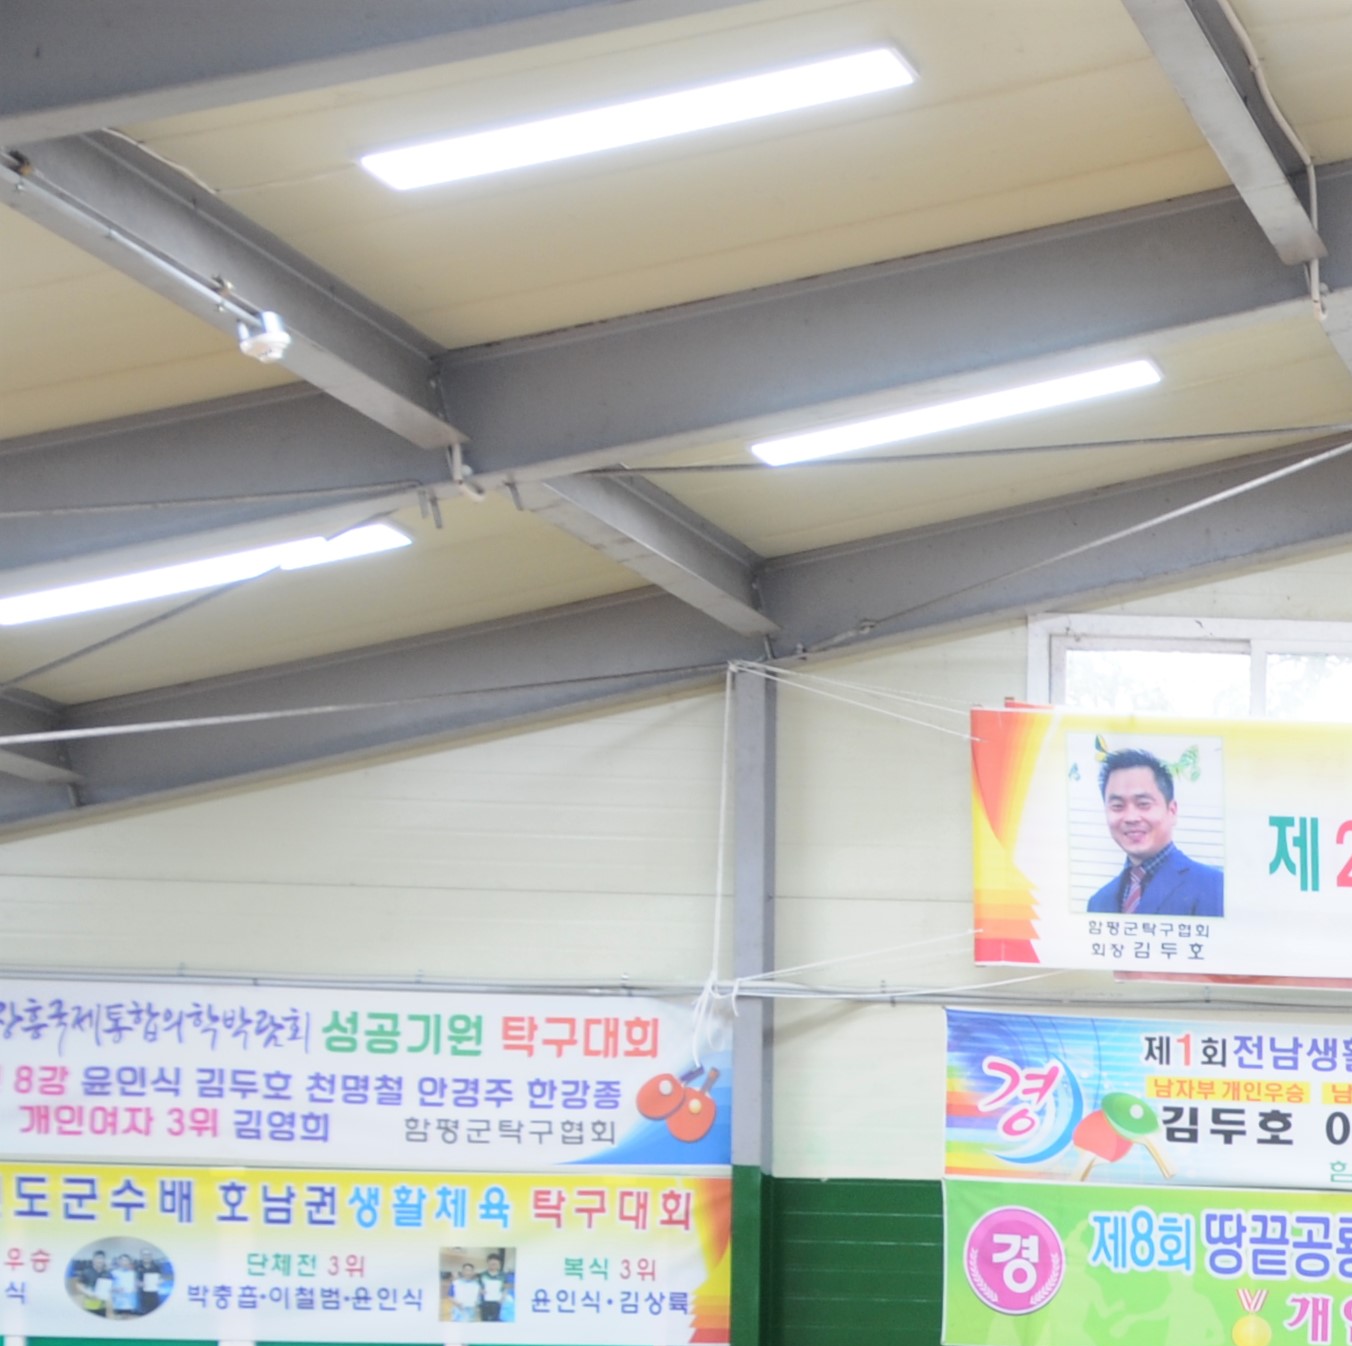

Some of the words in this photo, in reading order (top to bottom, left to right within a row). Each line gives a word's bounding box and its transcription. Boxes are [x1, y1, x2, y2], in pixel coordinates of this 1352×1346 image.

[321, 1010, 484, 1056] 성공기원
[501, 1015, 660, 1059] 탁구대회
[14, 1065, 70, 1096] 8강
[195, 1067, 293, 1101] 김두호
[305, 1072, 404, 1106] 천명철
[417, 1075, 514, 1109] 안경주
[526, 1078, 622, 1110] 한강종
[978, 1059, 1061, 1137] 경
[1153, 1078, 1216, 1101] 남자부
[1222, 1080, 1306, 1104] 개인우승
[18, 1105, 154, 1136] 개인여자
[167, 1107, 219, 1138] 3위
[233, 1109, 330, 1142] 김영희
[404, 1116, 616, 1145] 함평군탁구협회
[1161, 1105, 1295, 1146] 김두호
[532, 1189, 693, 1231] 탁구대회
[1090, 1209, 1193, 1272] 제8회
[246, 1252, 317, 1277] 단체전
[991, 1232, 1039, 1293] 경
